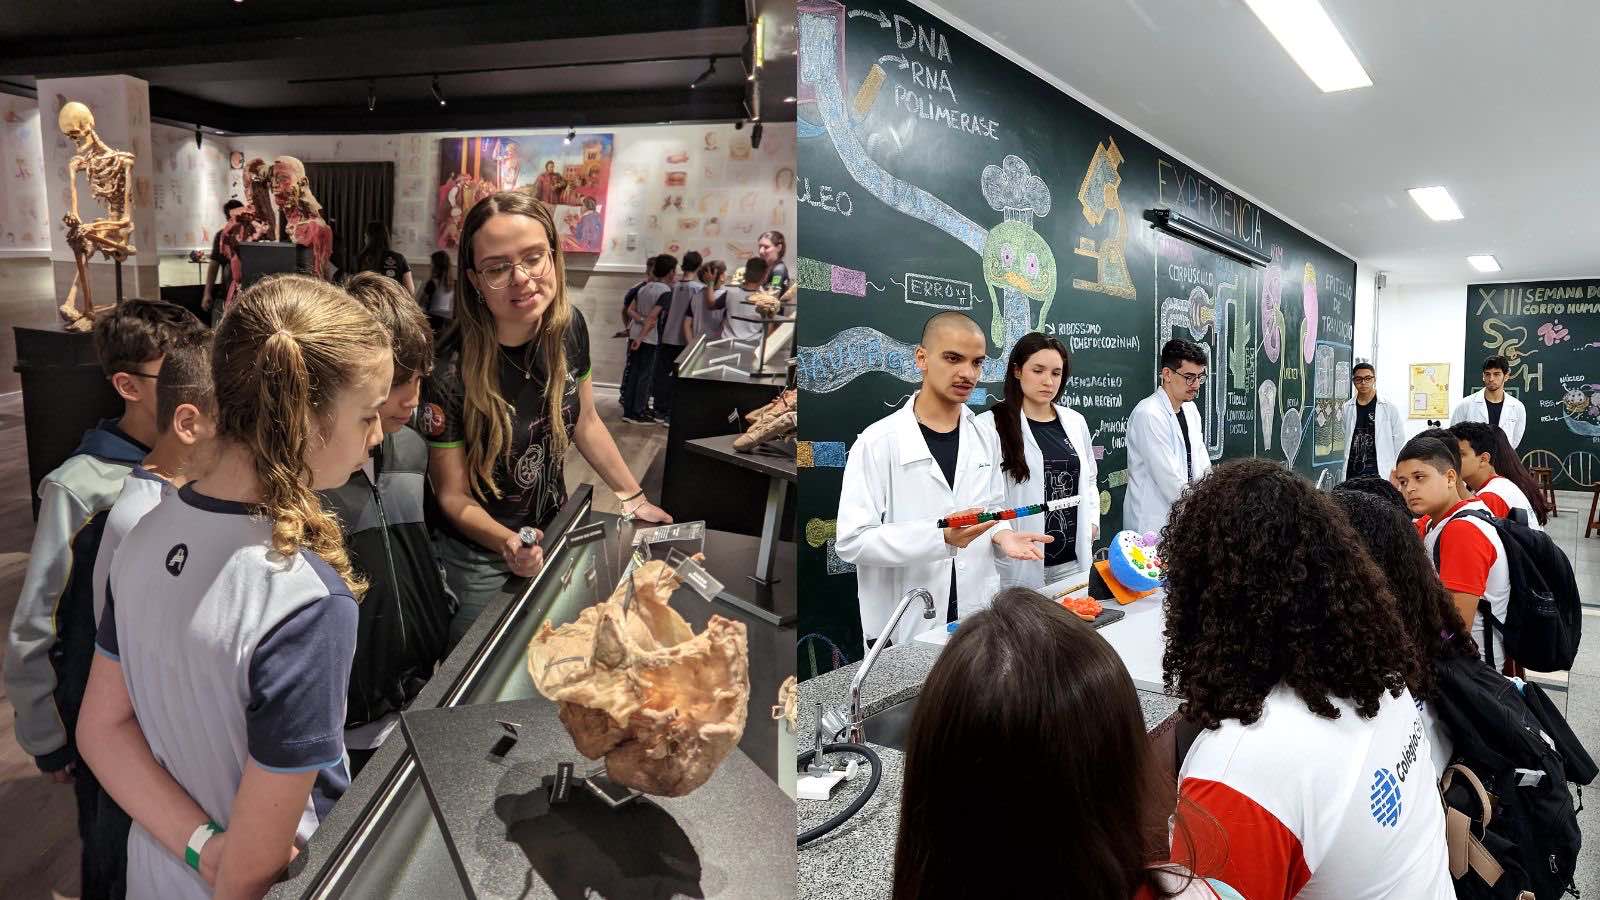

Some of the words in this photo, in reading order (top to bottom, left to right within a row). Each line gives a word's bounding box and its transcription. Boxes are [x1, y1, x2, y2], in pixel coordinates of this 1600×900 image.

[893, 14, 953, 64] DNA
[911, 61, 959, 104] RNA
[1476, 287, 1523, 316] XIII
[1522, 303, 1565, 315] CORPO
[1524, 286, 1584, 303] SEMANA
[1058, 322, 1102, 335] RIBOSSOMO
[1395, 733, 1419, 783] Colégio
